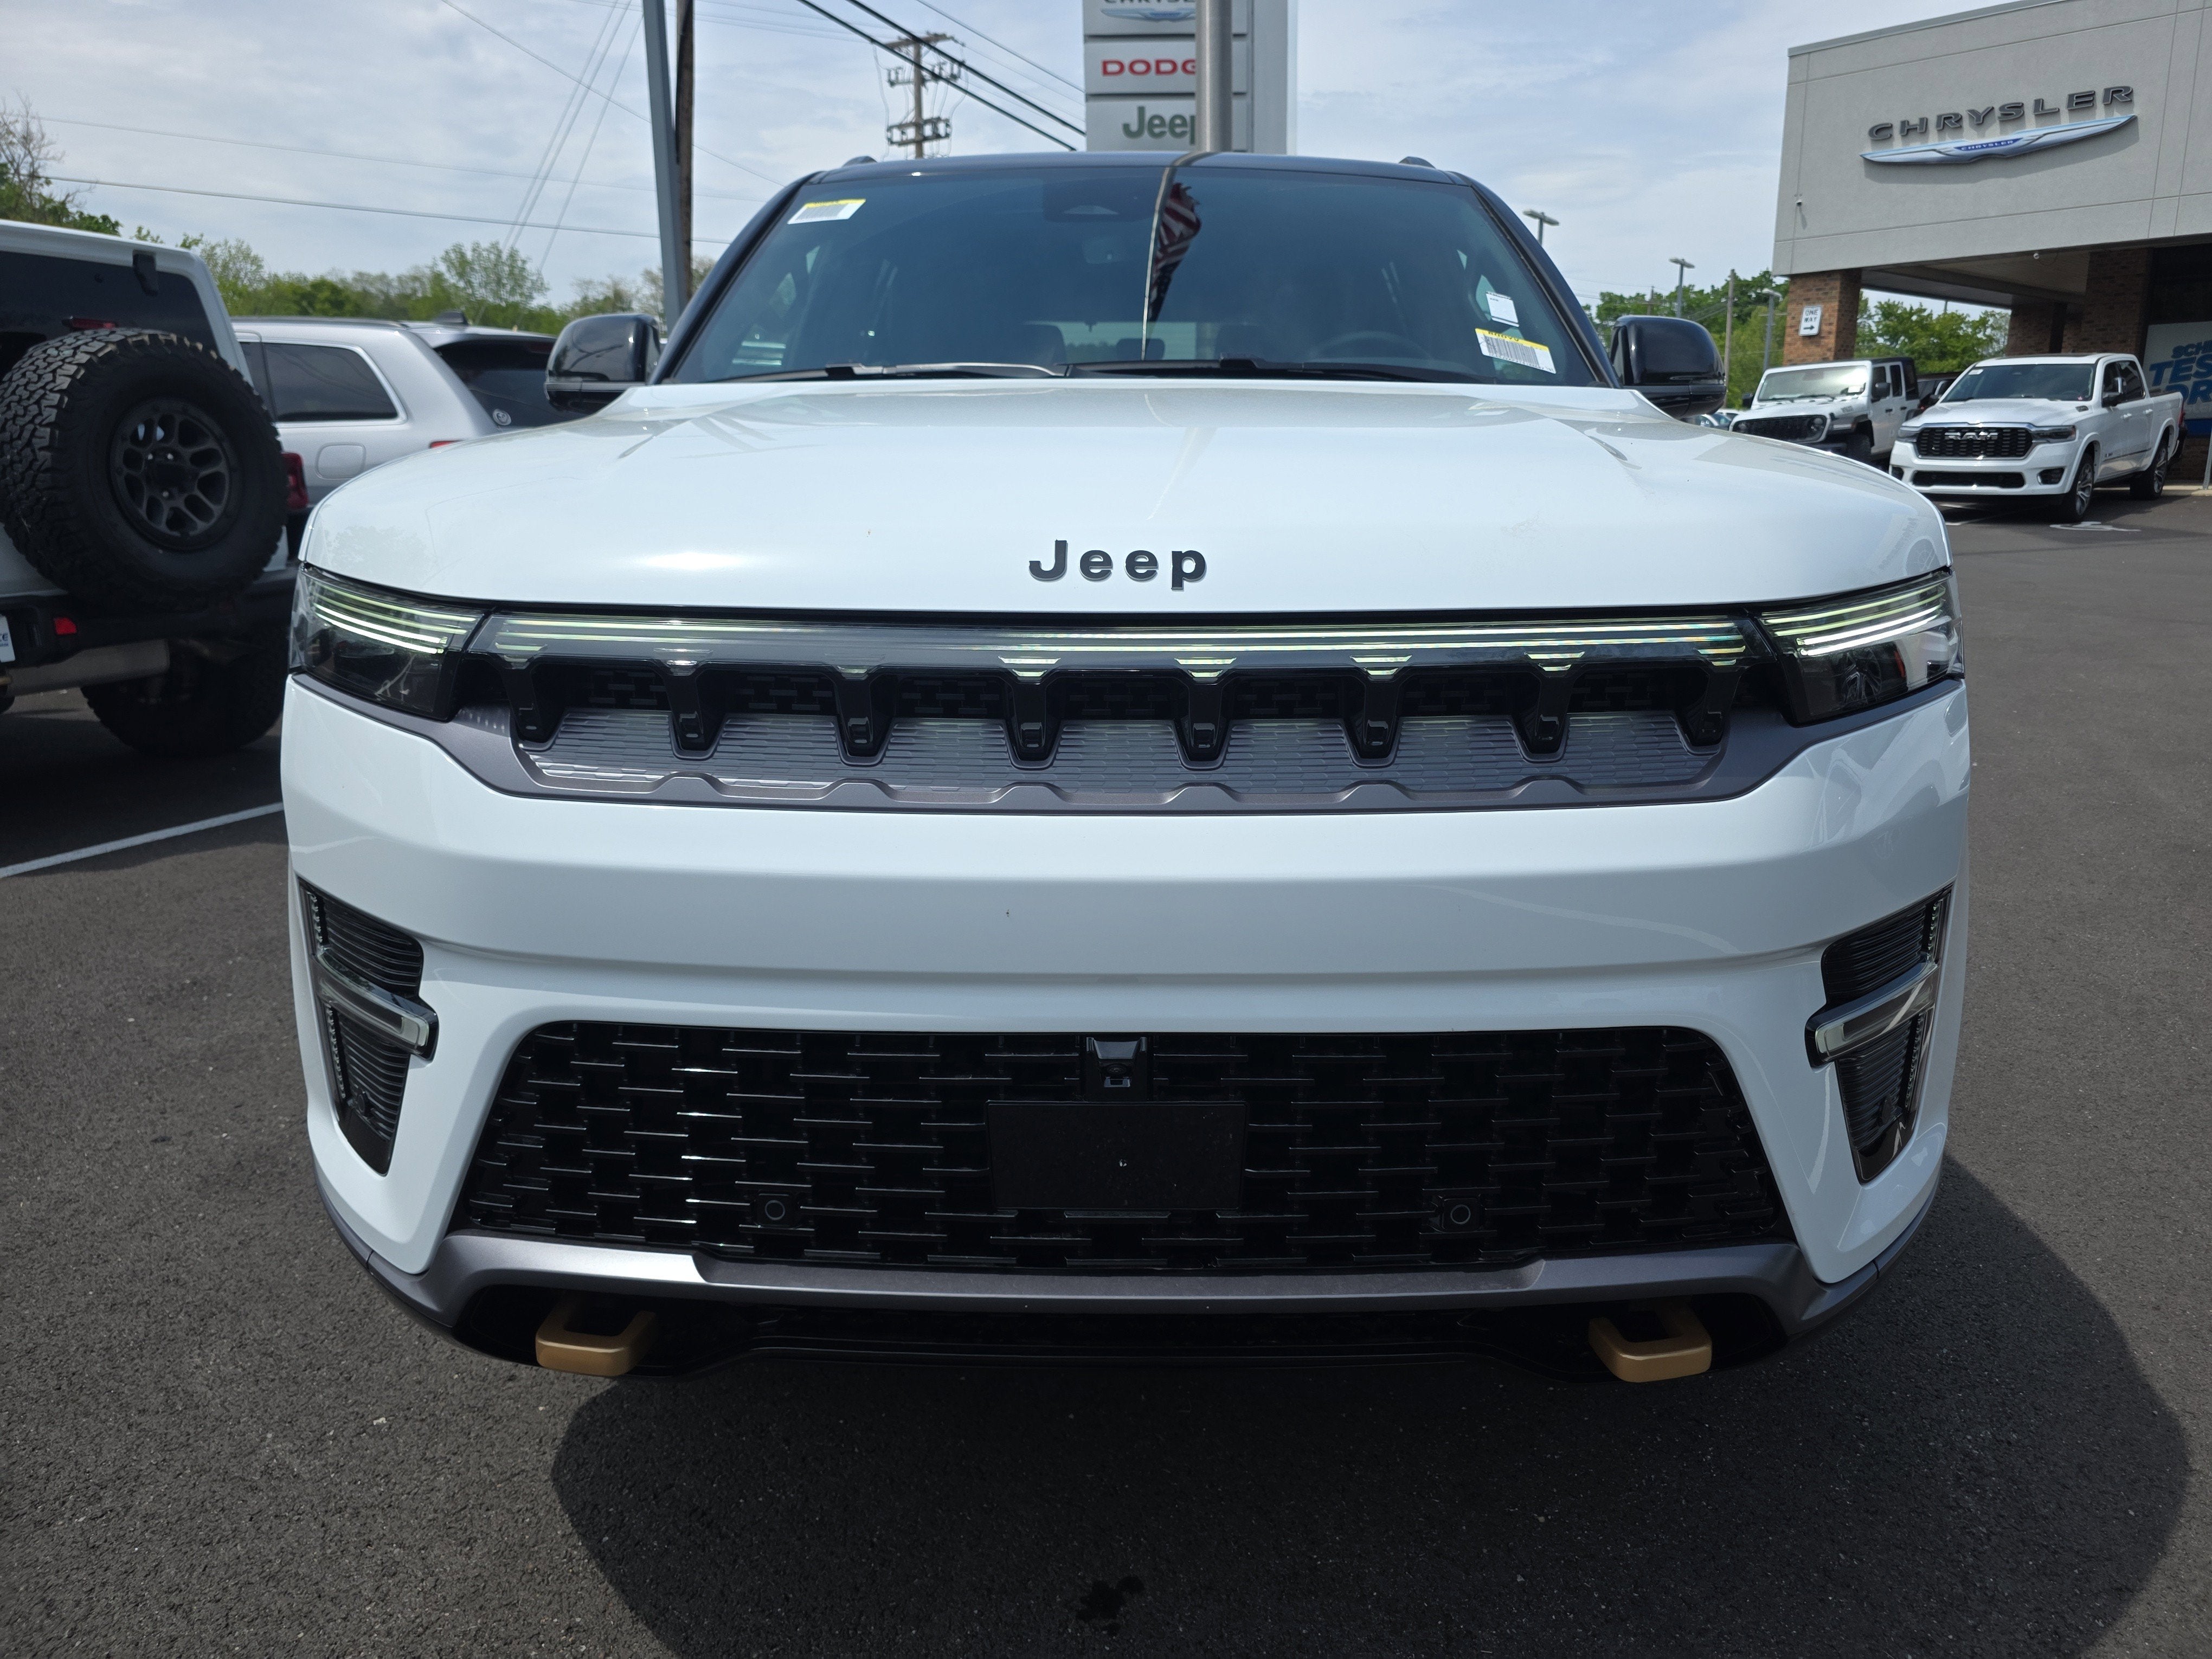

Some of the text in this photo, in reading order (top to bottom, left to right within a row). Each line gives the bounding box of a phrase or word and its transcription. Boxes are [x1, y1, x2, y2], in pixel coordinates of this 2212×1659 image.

[1102, 59, 1195, 75] DODG
[1122, 106, 1195, 145] Jee
[1868, 85, 2134, 140] CHRYSLER
[1028, 540, 1207, 591] Jeep
